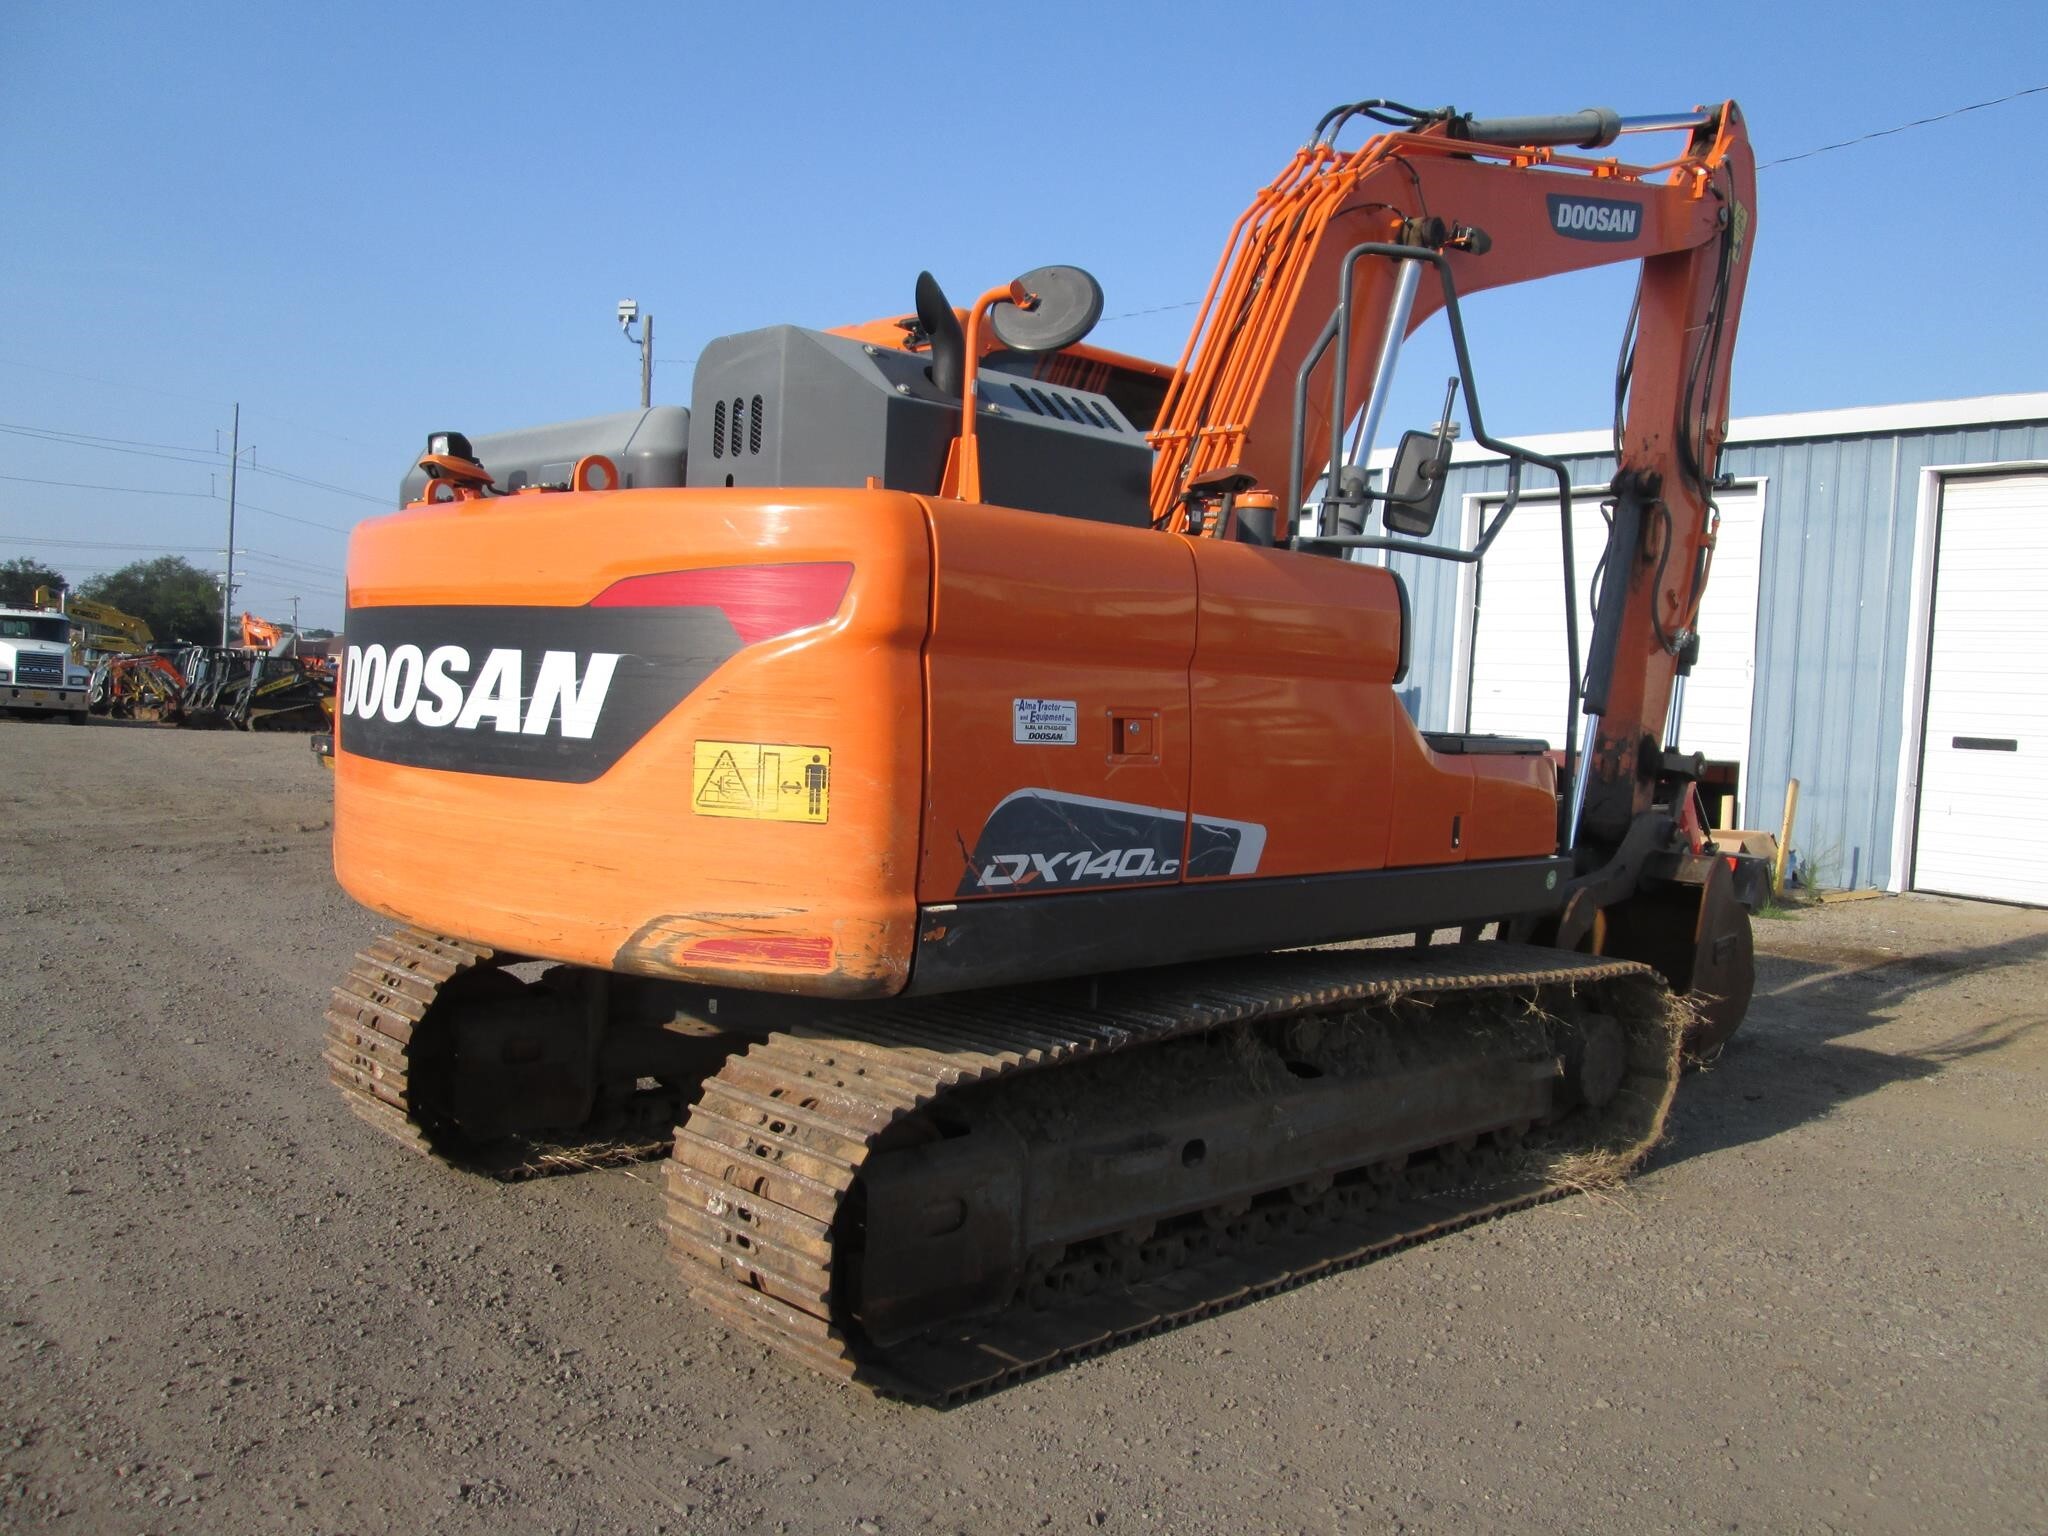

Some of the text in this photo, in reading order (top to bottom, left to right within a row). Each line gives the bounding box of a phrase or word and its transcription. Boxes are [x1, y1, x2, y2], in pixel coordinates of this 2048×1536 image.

[1557, 203, 1636, 232] DOOSAN
[343, 644, 619, 738] DOOSAN
[1018, 699, 1061, 712] Alma Tractor
[1030, 711, 1065, 723] Equipment
